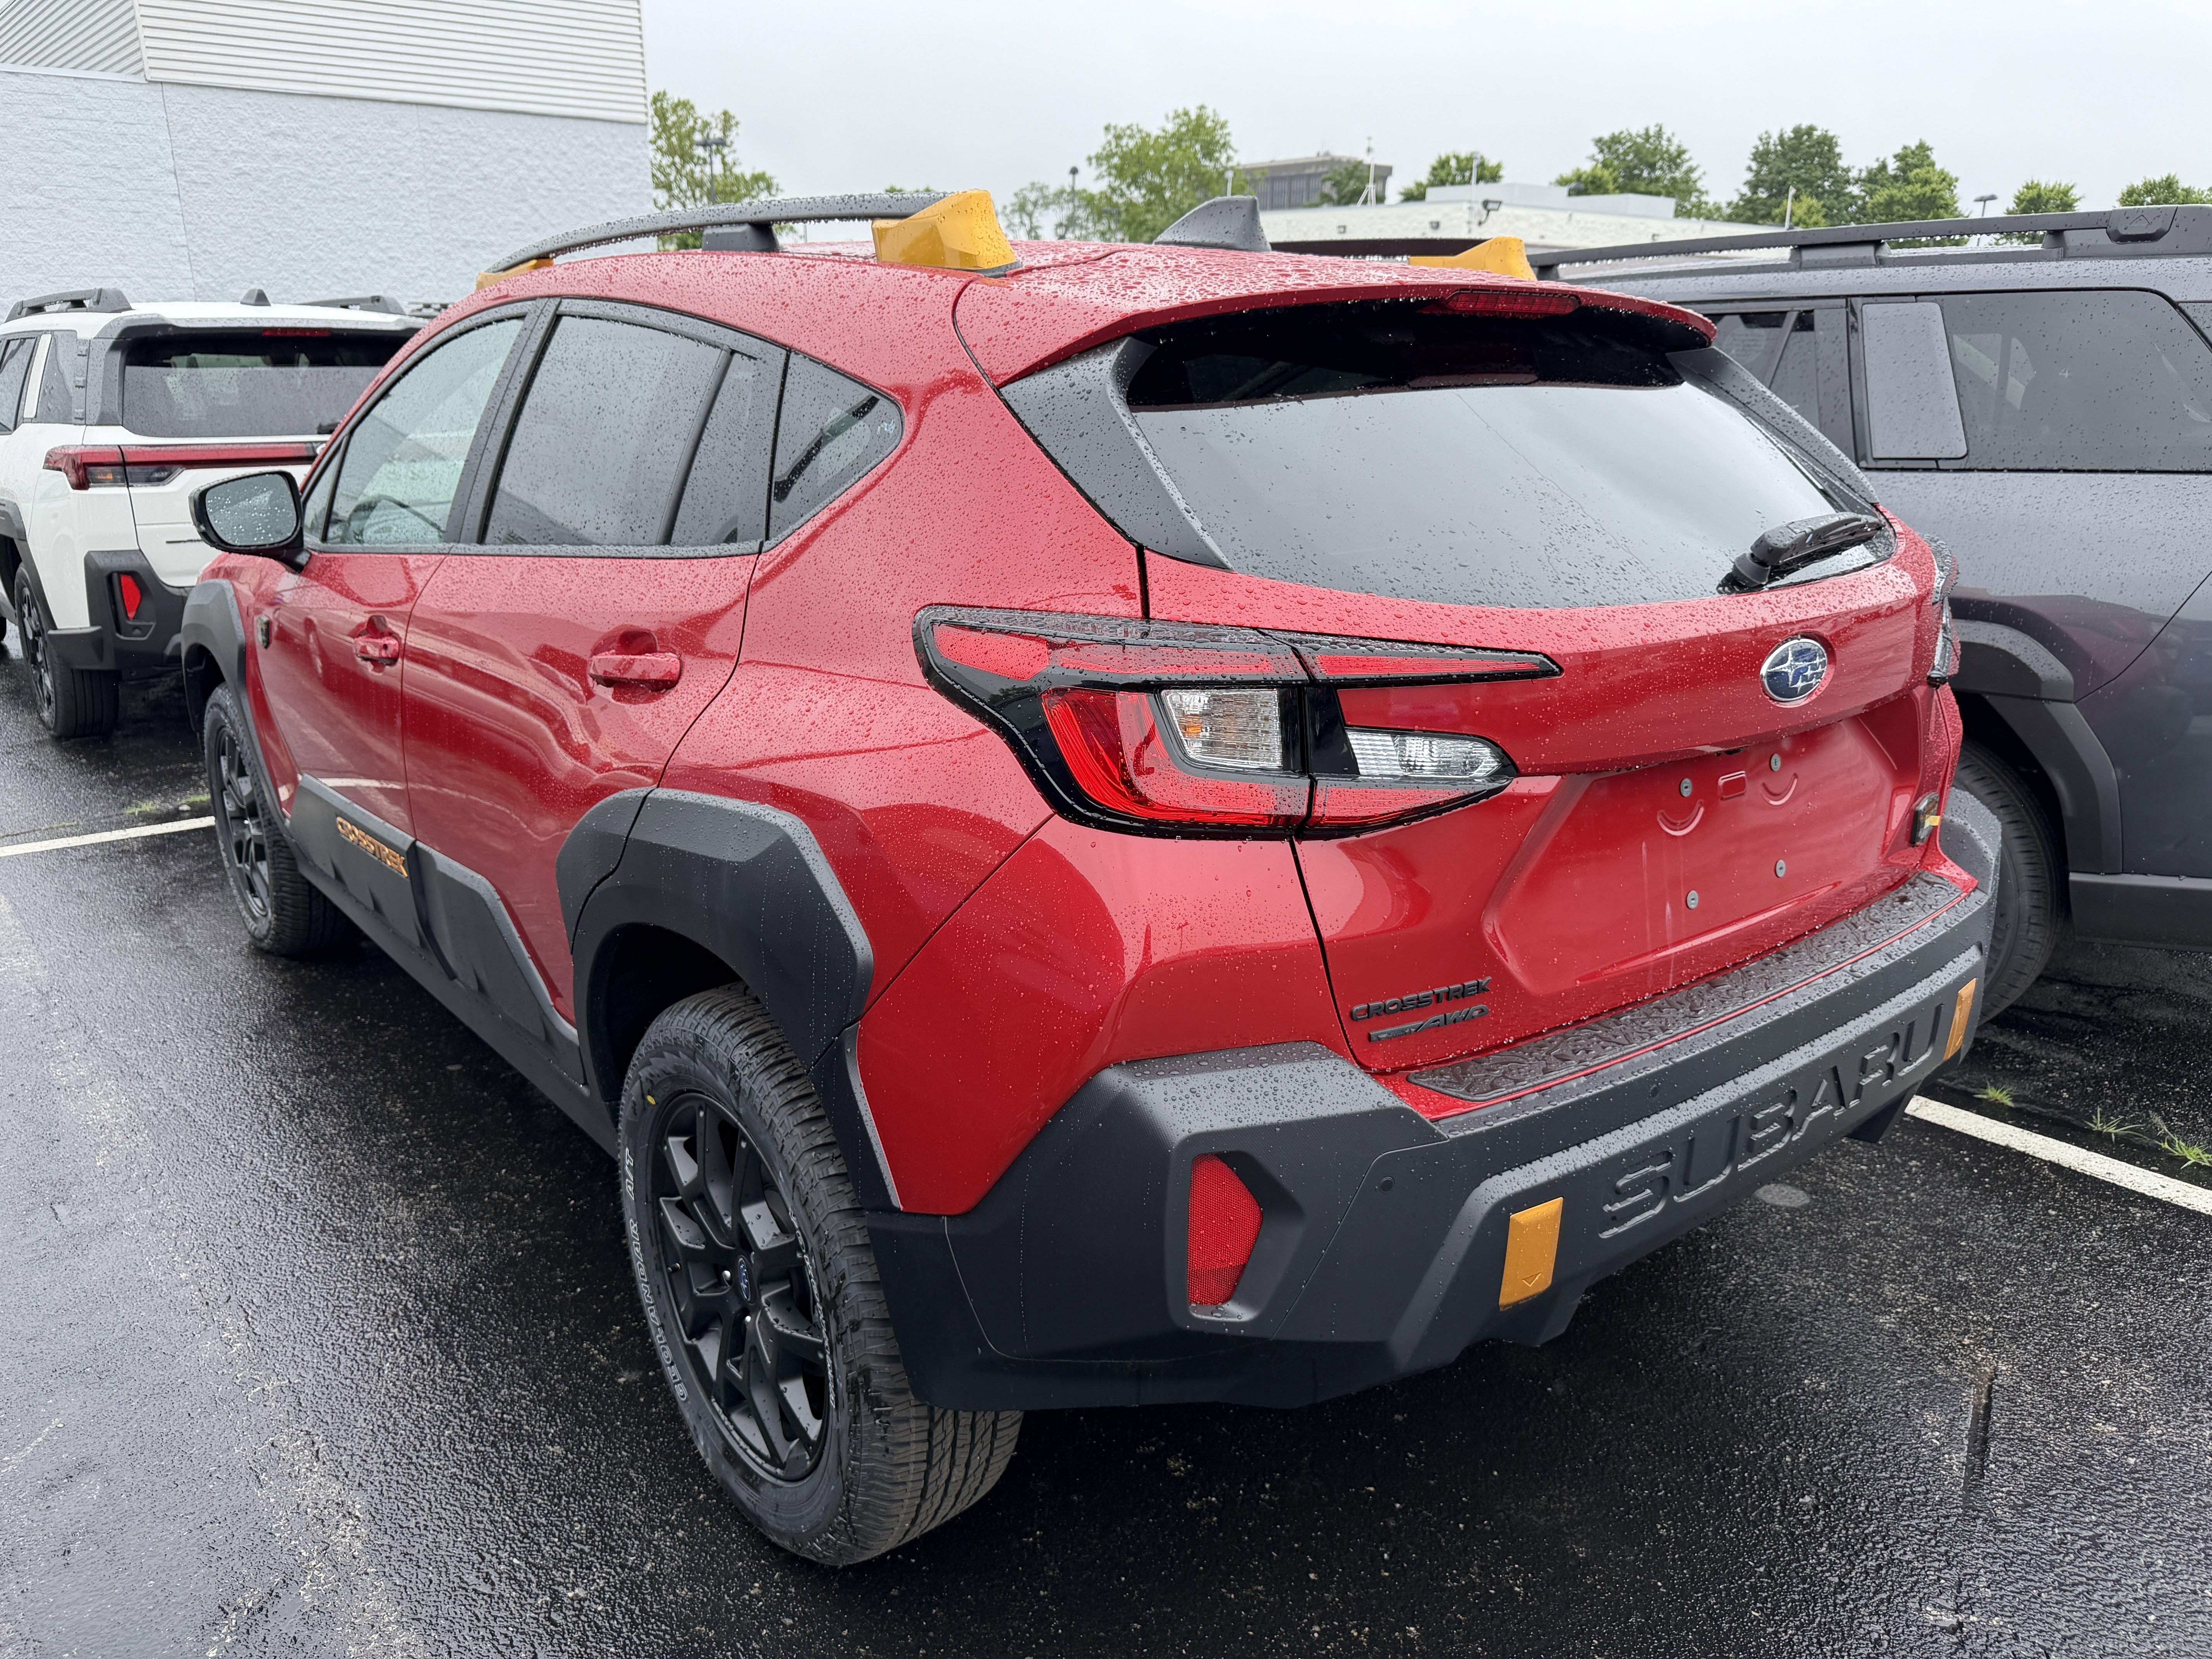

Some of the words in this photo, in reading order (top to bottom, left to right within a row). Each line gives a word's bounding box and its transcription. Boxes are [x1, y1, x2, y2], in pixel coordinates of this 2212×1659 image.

[1351, 975, 1492, 1022] CROSSTREK
[1417, 1004, 1490, 1032] AWD
[1598, 1002, 1943, 1239] SUBARU
[625, 1147, 635, 1201] A/T
[629, 1218, 688, 1401] GEOLANDAR
